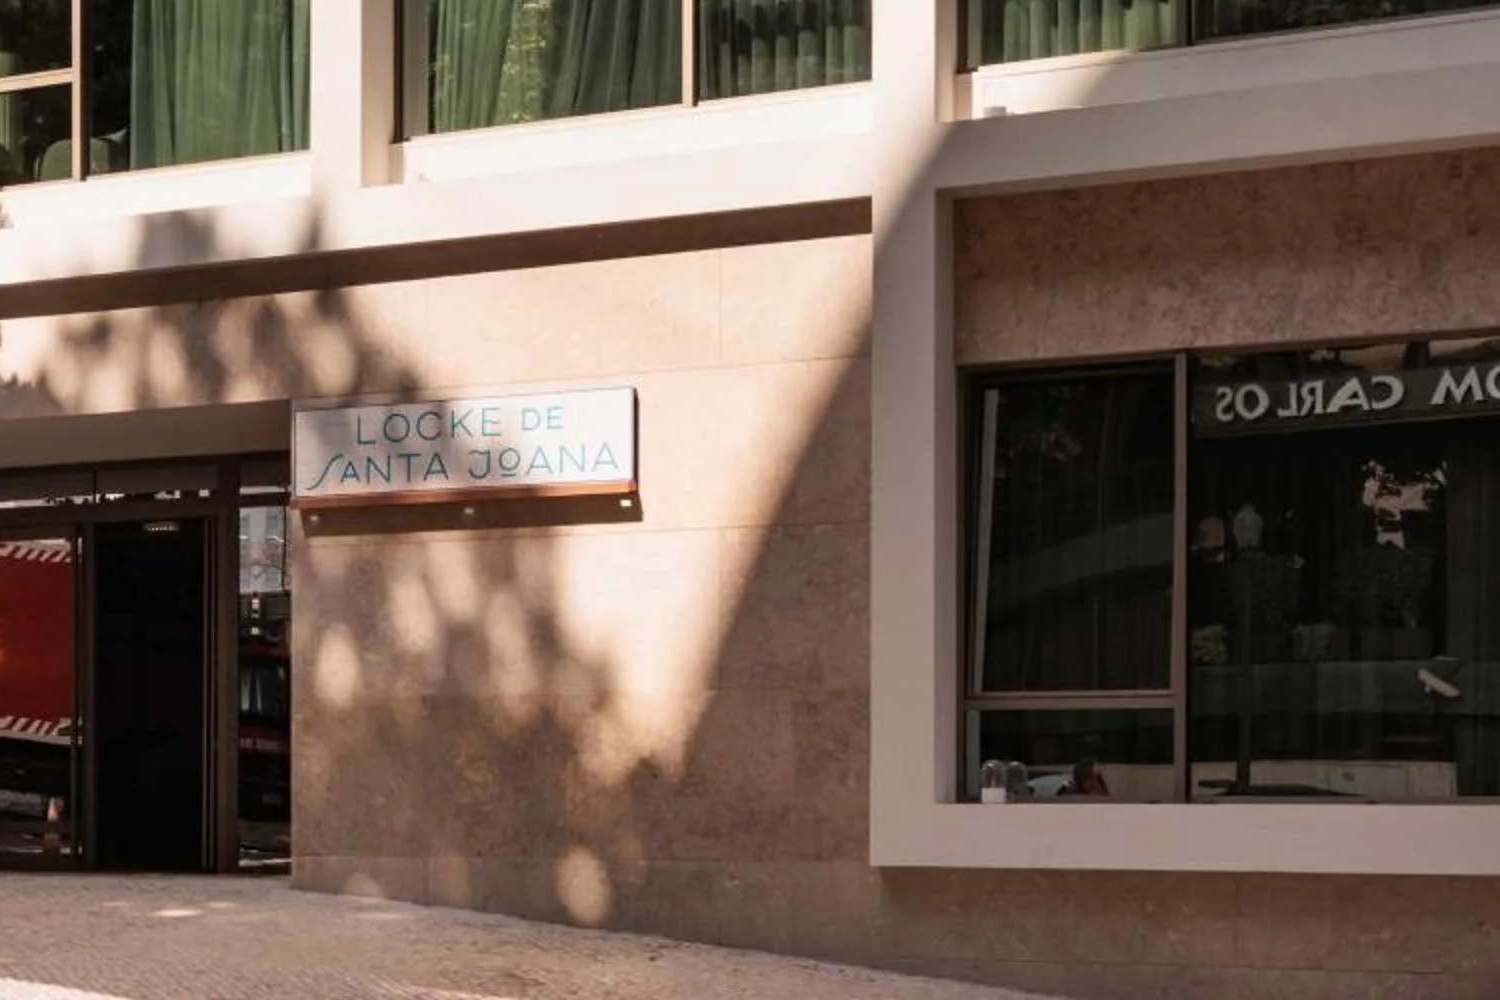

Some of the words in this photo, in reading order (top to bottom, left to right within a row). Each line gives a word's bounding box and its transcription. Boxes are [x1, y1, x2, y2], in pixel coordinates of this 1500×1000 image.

[356, 407, 502, 446] LOCKE
[520, 406, 564, 431] DE
[305, 452, 449, 491] SANTA
[468, 442, 620, 480] JOANA
